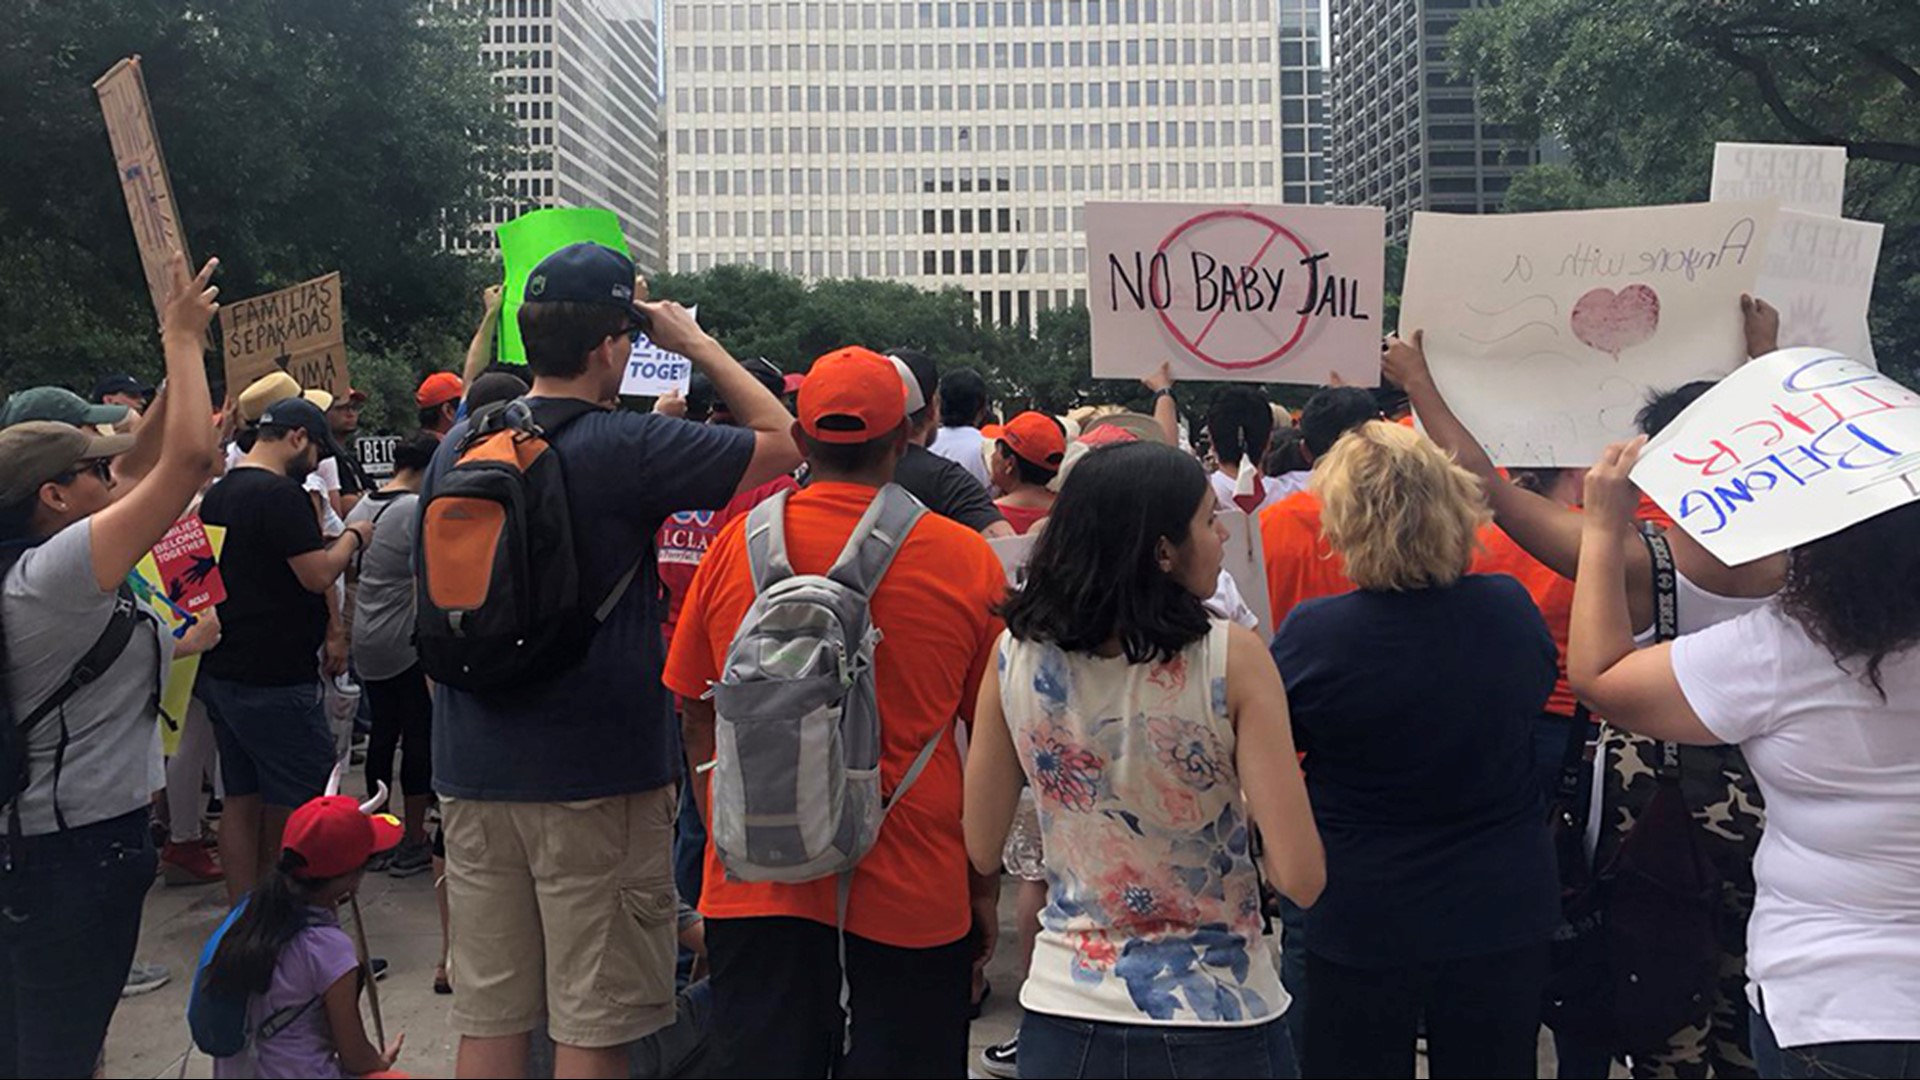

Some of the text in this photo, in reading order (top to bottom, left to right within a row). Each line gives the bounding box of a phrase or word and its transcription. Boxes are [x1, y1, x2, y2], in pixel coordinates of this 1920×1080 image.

[232, 283, 333, 330] FAMILIAS
[1108, 251, 1370, 321] NO BABY JAIL
[230, 303, 333, 359] SEPARADAS
[292, 352, 337, 387] UMA
[1680, 420, 1901, 535] BELONG
[153, 528, 204, 555] BELONG
[663, 529, 717, 550] LCLA
